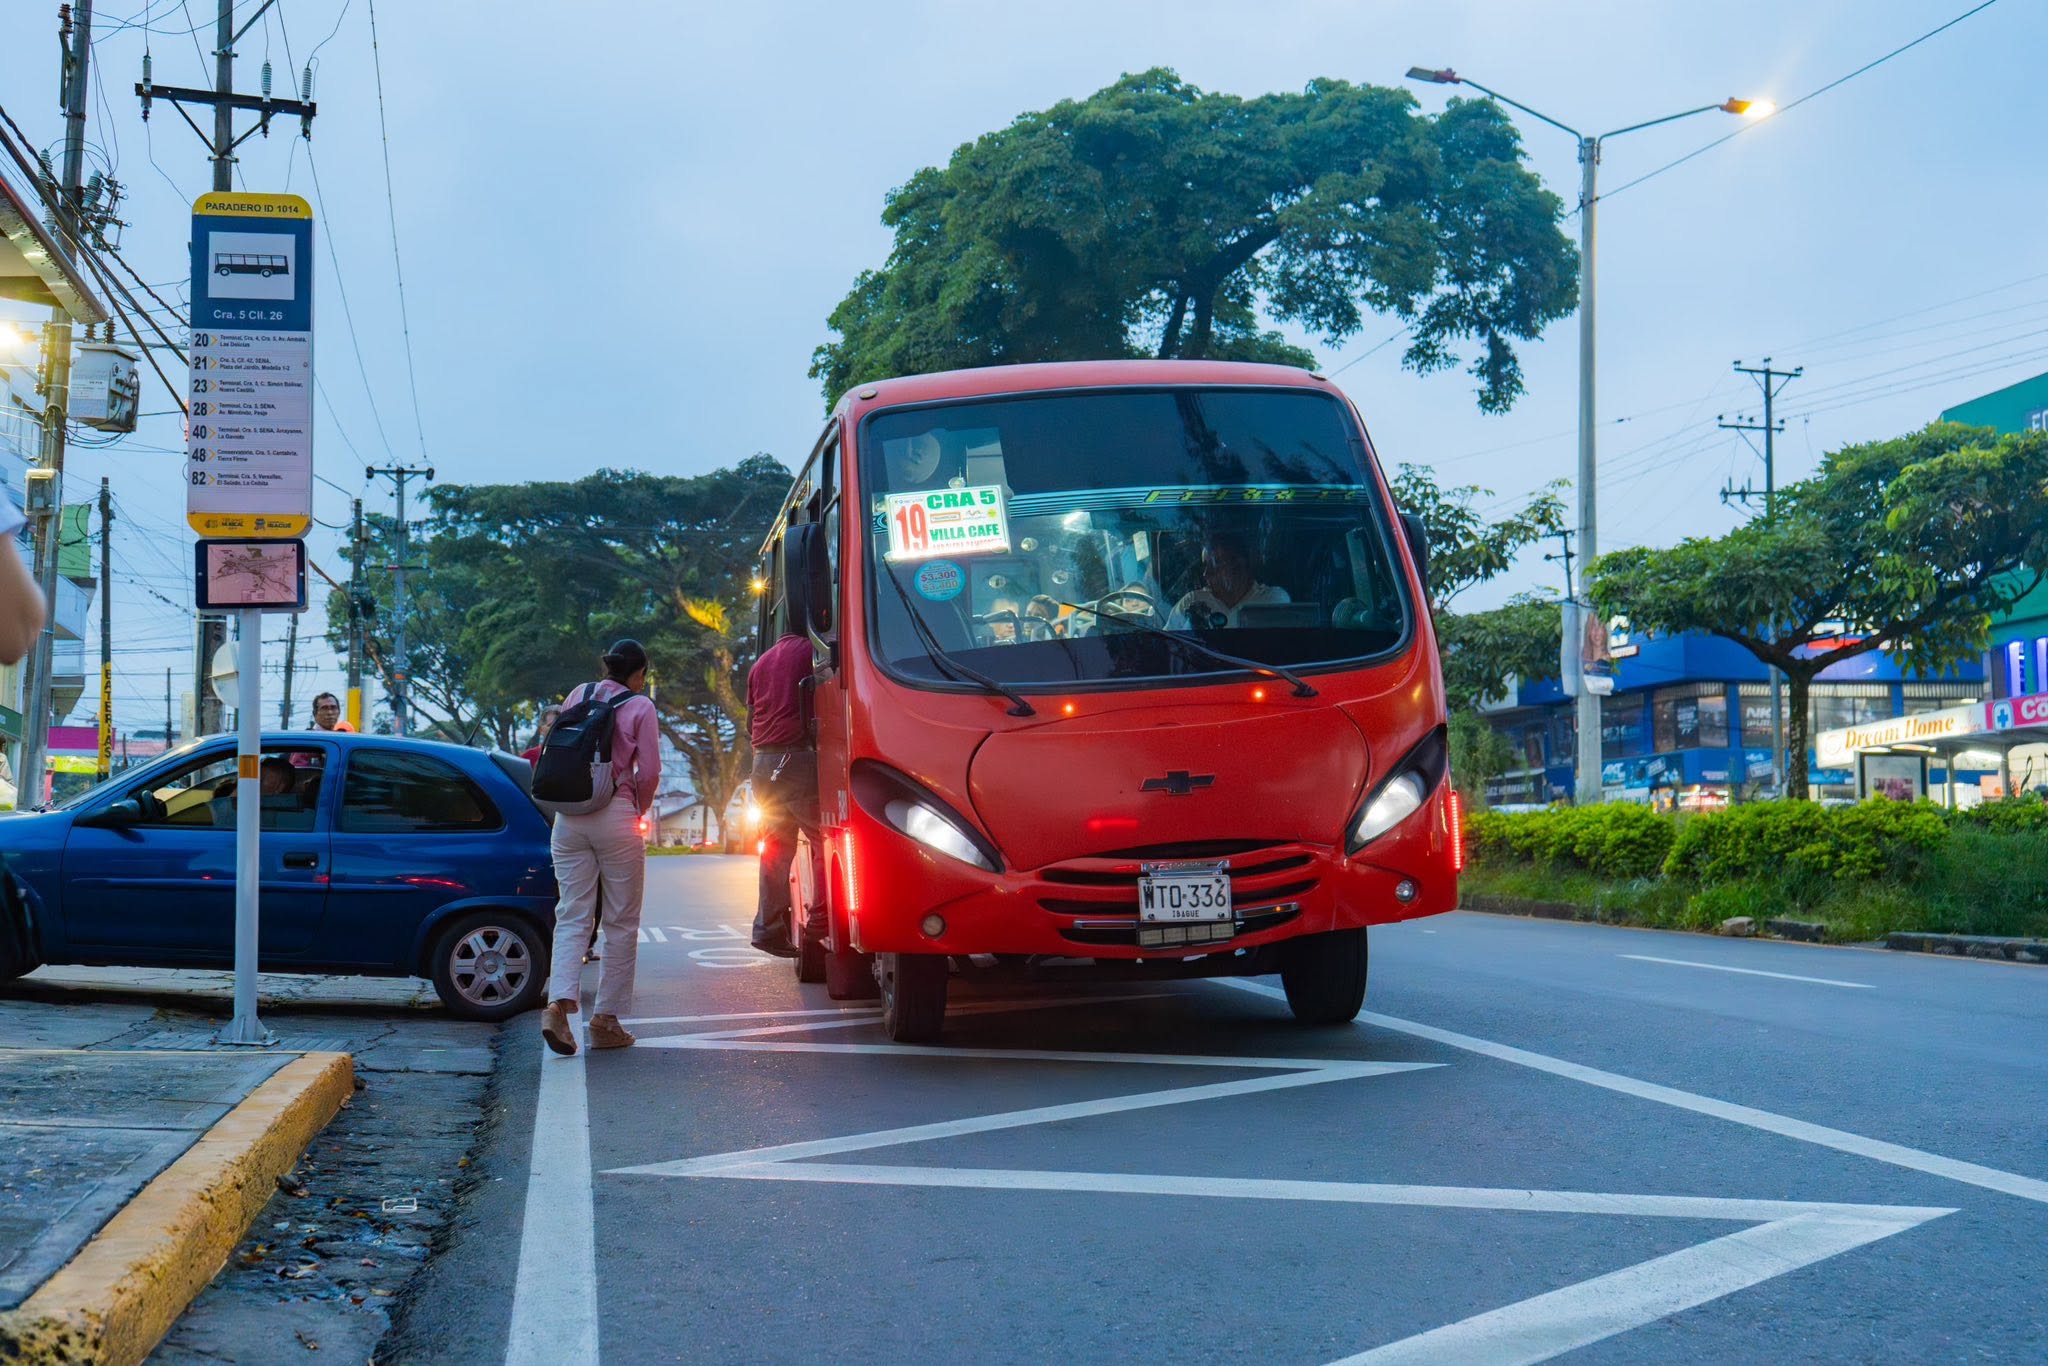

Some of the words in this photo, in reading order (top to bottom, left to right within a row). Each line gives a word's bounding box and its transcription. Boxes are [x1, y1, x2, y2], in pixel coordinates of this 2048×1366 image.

[206, 202, 262, 212] PARADERO
[264, 204, 274, 212] ID
[278, 205, 298, 213] 1014
[214, 310, 236, 319] Cra.
[240, 311, 246, 319] 5
[270, 312, 283, 320] 26
[194, 333, 209, 347] 20
[194, 356, 207, 370] 21
[193, 379, 207, 392] 23
[193, 402, 207, 416] 28
[193, 425, 207, 439] 40
[192, 448, 206, 462] 48
[192, 472, 206, 485] 82
[926, 492, 975, 510] CRA
[980, 490, 996, 505] 5
[896, 503, 928, 550] 19
[930, 525, 966, 542] VILLA
[968, 523, 999, 538] CAFE
[921, 570, 957, 583] $3.300
[1845, 728, 1900, 750] Dream
[1905, 717, 1955, 738] Home
